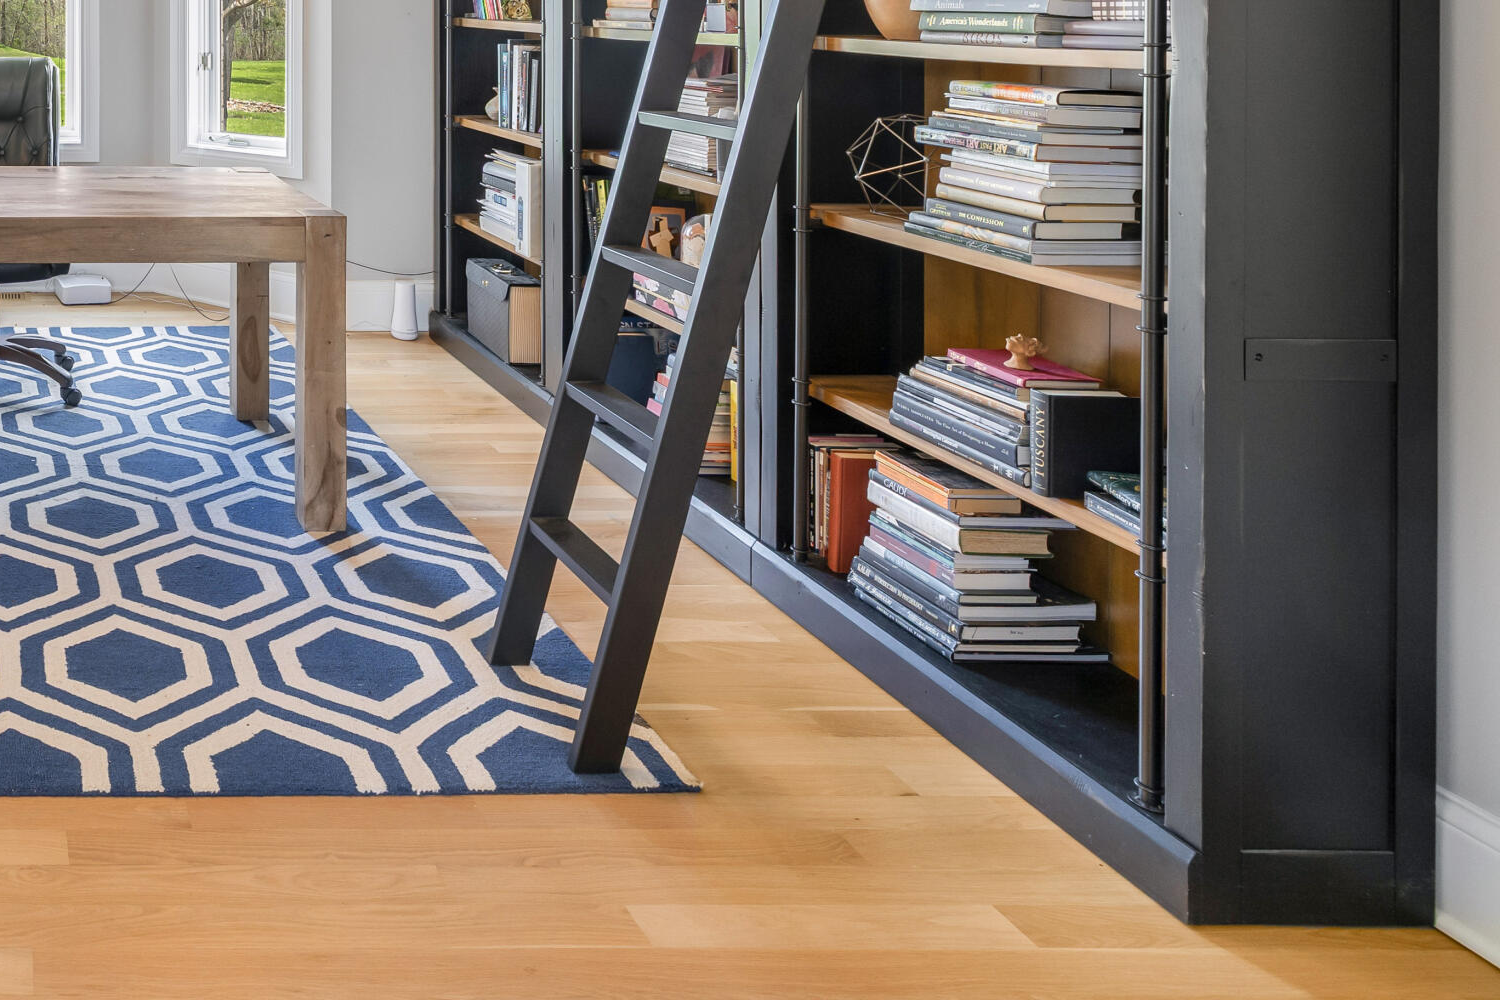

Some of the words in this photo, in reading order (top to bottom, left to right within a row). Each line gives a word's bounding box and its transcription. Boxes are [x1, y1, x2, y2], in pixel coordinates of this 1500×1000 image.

[935, 0, 964, 9] Animals
[966, 140, 979, 152] ART
[992, 144, 1007, 154] ART
[967, 213, 1004, 227] CONFESSION
[1035, 406, 1045, 477] TUSCANY
[1109, 486, 1131, 507] History
